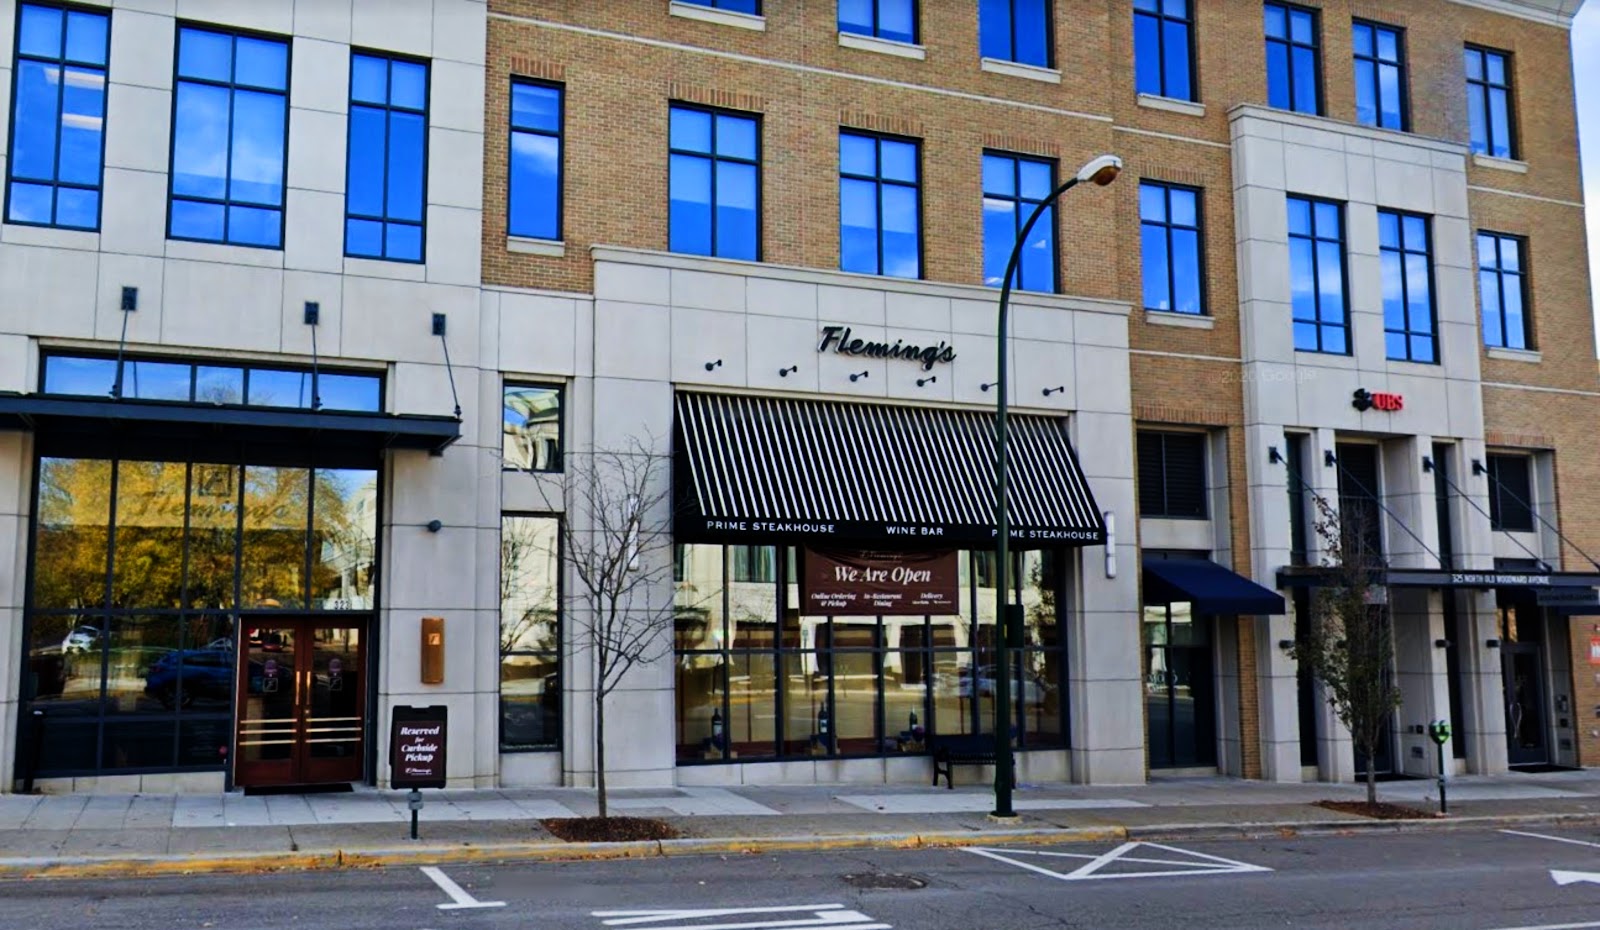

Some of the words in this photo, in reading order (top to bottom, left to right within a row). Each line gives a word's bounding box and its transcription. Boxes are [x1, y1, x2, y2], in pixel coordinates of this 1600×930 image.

[818, 326, 957, 371] Fleming's
[1374, 393, 1405, 412] UBS
[706, 520, 747, 531] PRIME
[752, 522, 835, 533] STEAKHOUSE
[886, 526, 916, 535] WINE
[921, 527, 944, 536] BAR
[992, 529, 1025, 538] PME
[1029, 530, 1099, 540] STEAKHOUSE
[834, 566, 858, 582] We
[860, 567, 889, 582] Are
[891, 567, 931, 585] Open
[1464, 574, 1483, 584] NORTH
[1484, 574, 1495, 584] OLD
[811, 592, 830, 600] Online
[831, 592, 856, 601] Ordering
[921, 592, 943, 600] Delivery
[334, 600, 350, 610] 323
[828, 600, 847, 608] Pickup
[874, 600, 892, 608] Dining
[400, 726, 440, 736] Reserved
[401, 743, 438, 752] Curbside
[405, 753, 434, 763] Pickup
